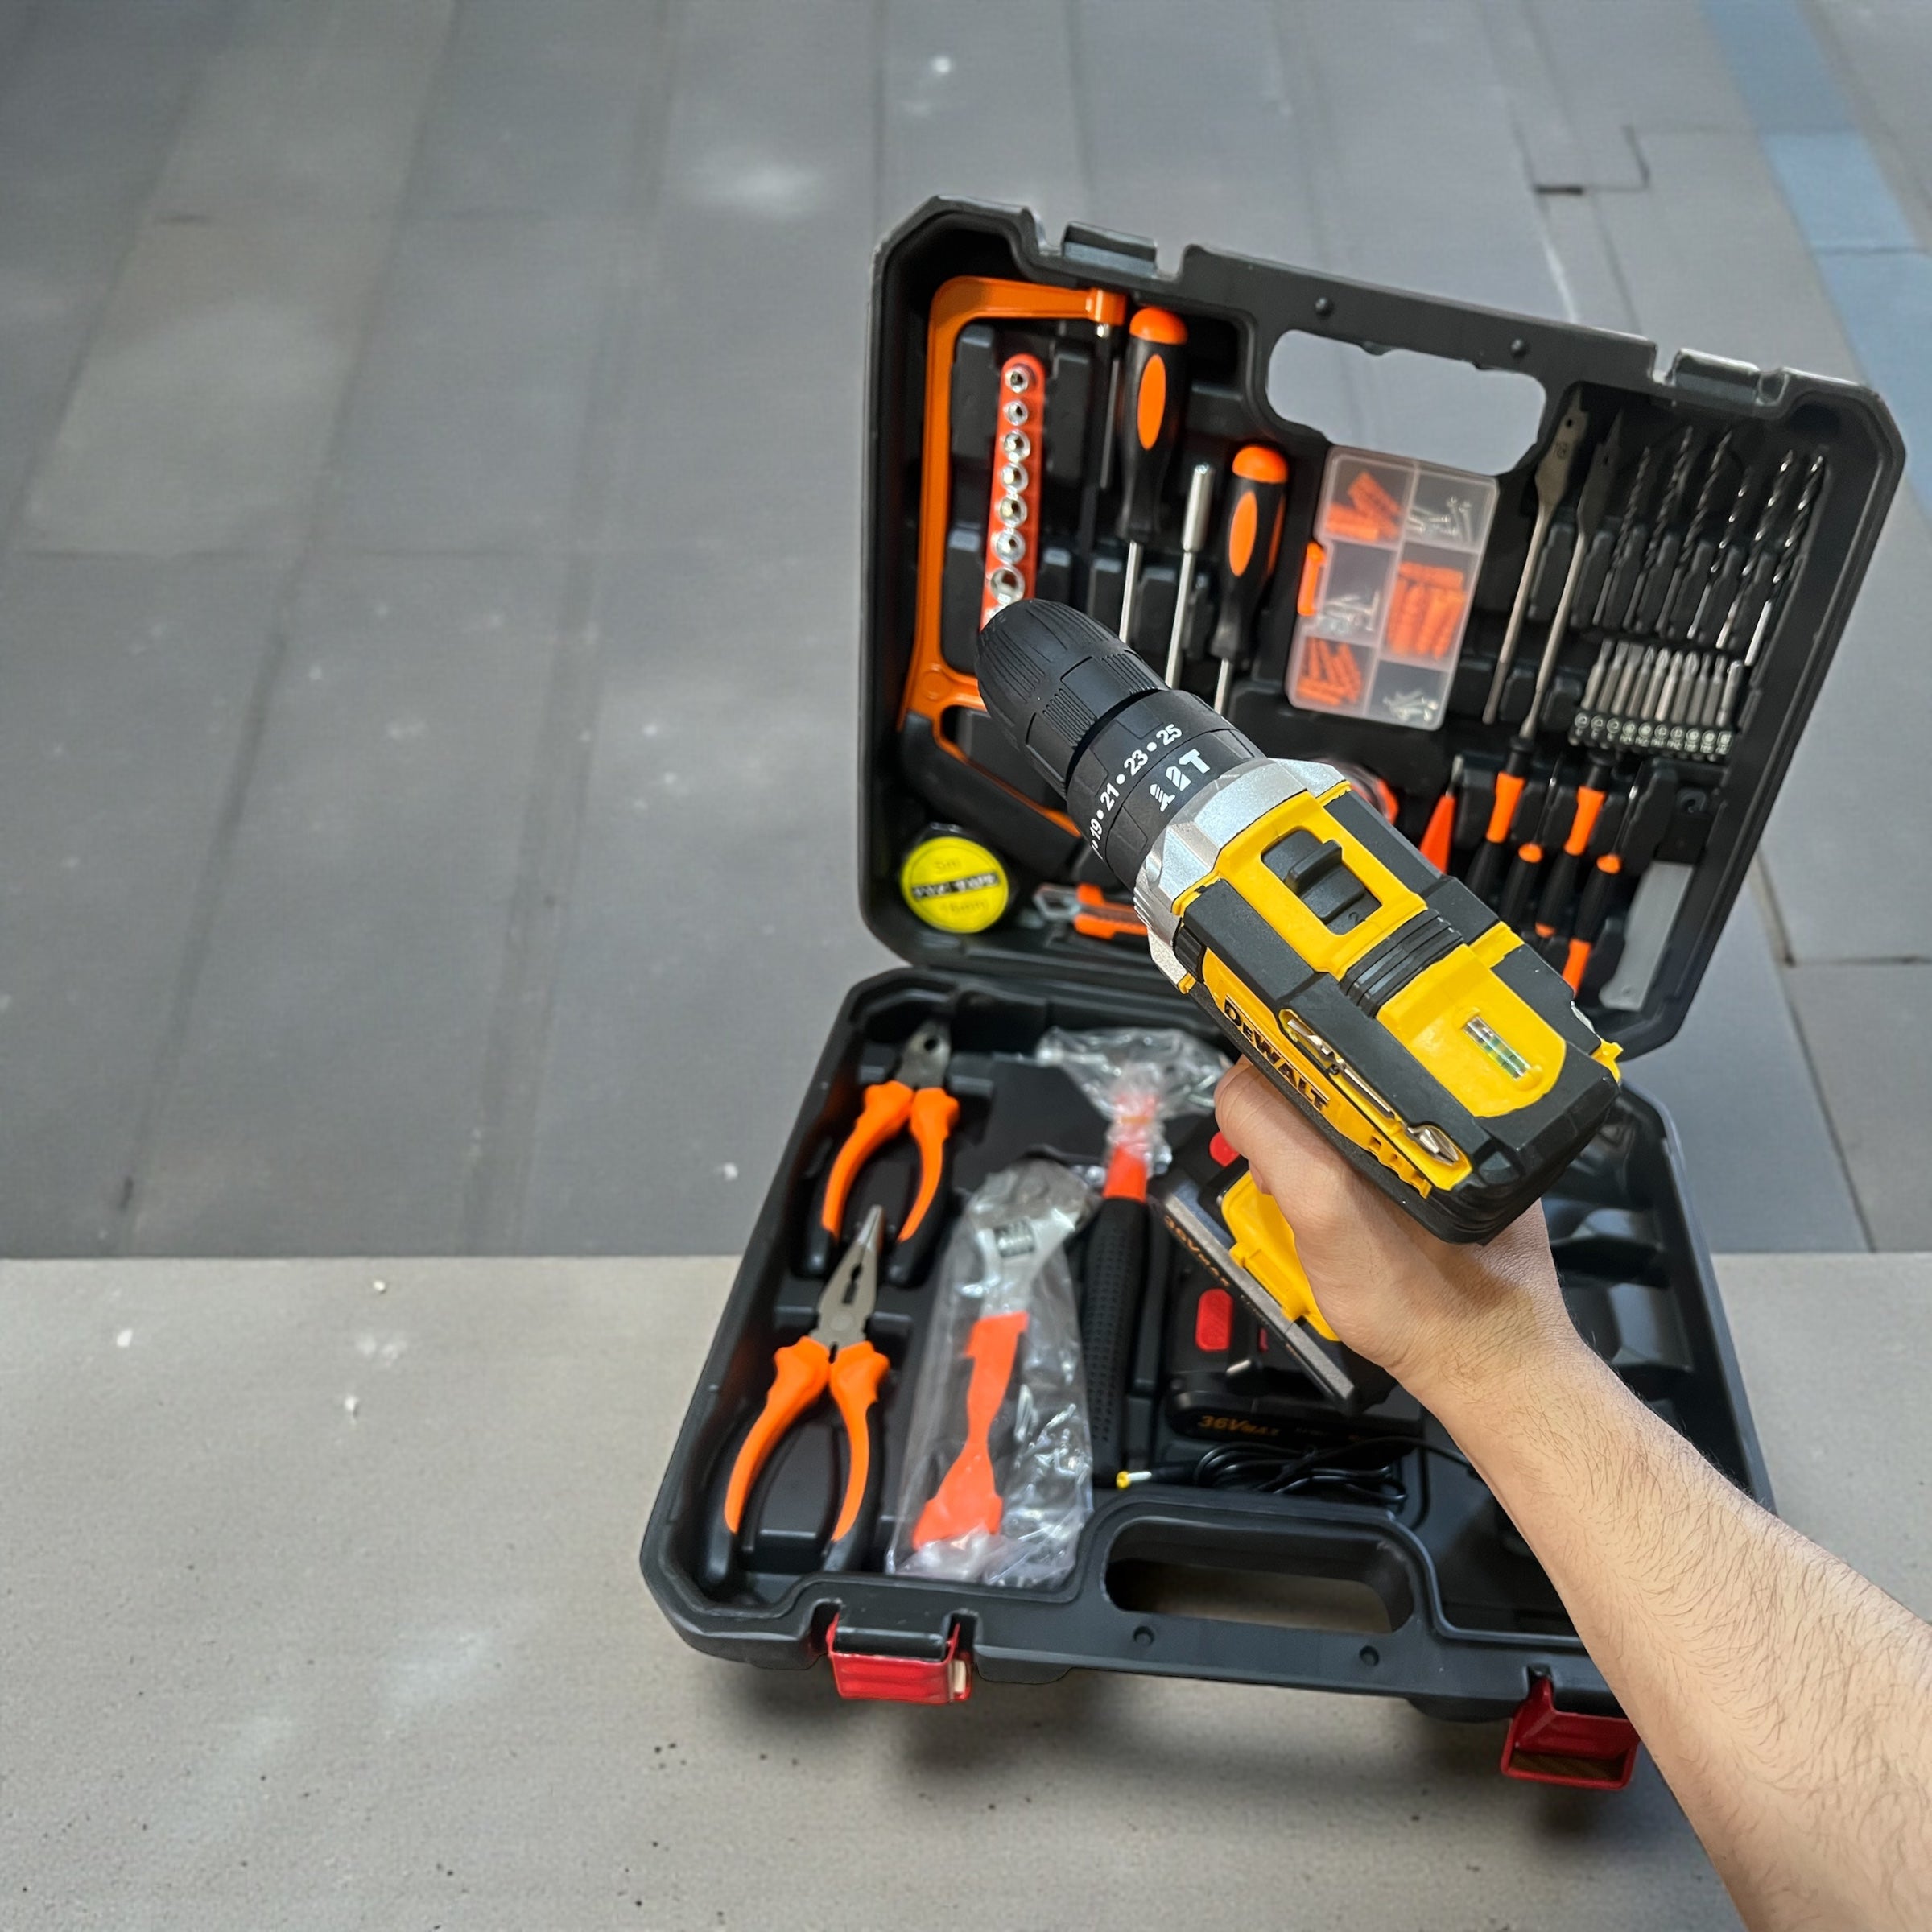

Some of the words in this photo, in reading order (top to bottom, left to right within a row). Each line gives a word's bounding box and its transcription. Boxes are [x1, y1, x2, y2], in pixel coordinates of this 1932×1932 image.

[1090, 818, 1103, 840] 19
[1100, 782, 1119, 811] 21
[1124, 749, 1149, 776] 23
[1156, 724, 1183, 745] 25
